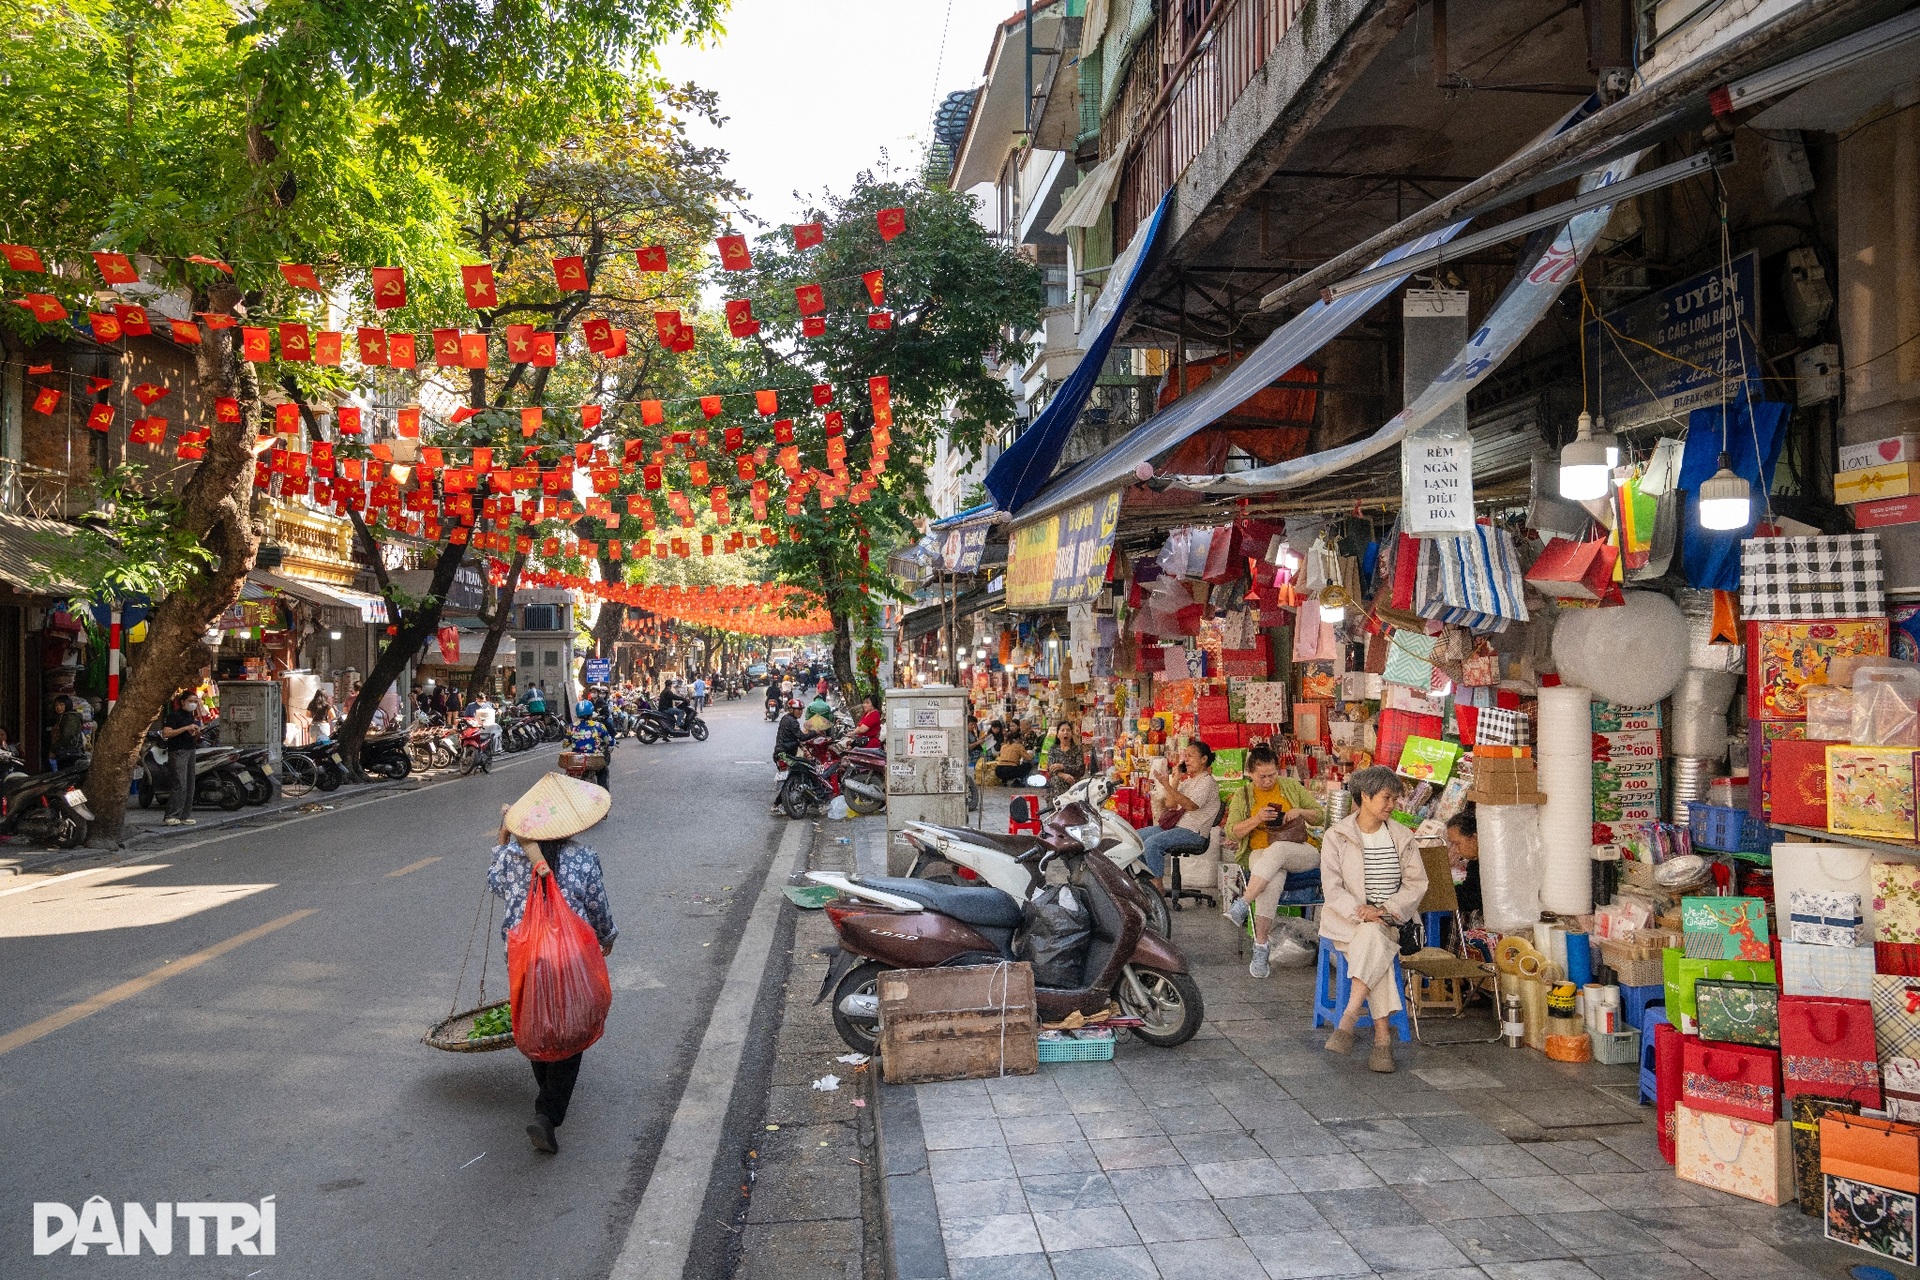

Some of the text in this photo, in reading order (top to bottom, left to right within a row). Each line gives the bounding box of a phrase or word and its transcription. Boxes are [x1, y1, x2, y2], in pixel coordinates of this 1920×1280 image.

[1675, 272, 1739, 314] UYÊN
[1423, 461, 1458, 473] NGĂN
[1842, 455, 1873, 471] LOVE
[1424, 479, 1459, 490] LẠNH
[1430, 507, 1455, 519] HÒA
[1820, 583, 1841, 591] TIMES
[1625, 720, 1648, 729] 400
[1634, 746, 1654, 756] 600
[1624, 780, 1648, 789] 400
[1626, 810, 1649, 819] 400
